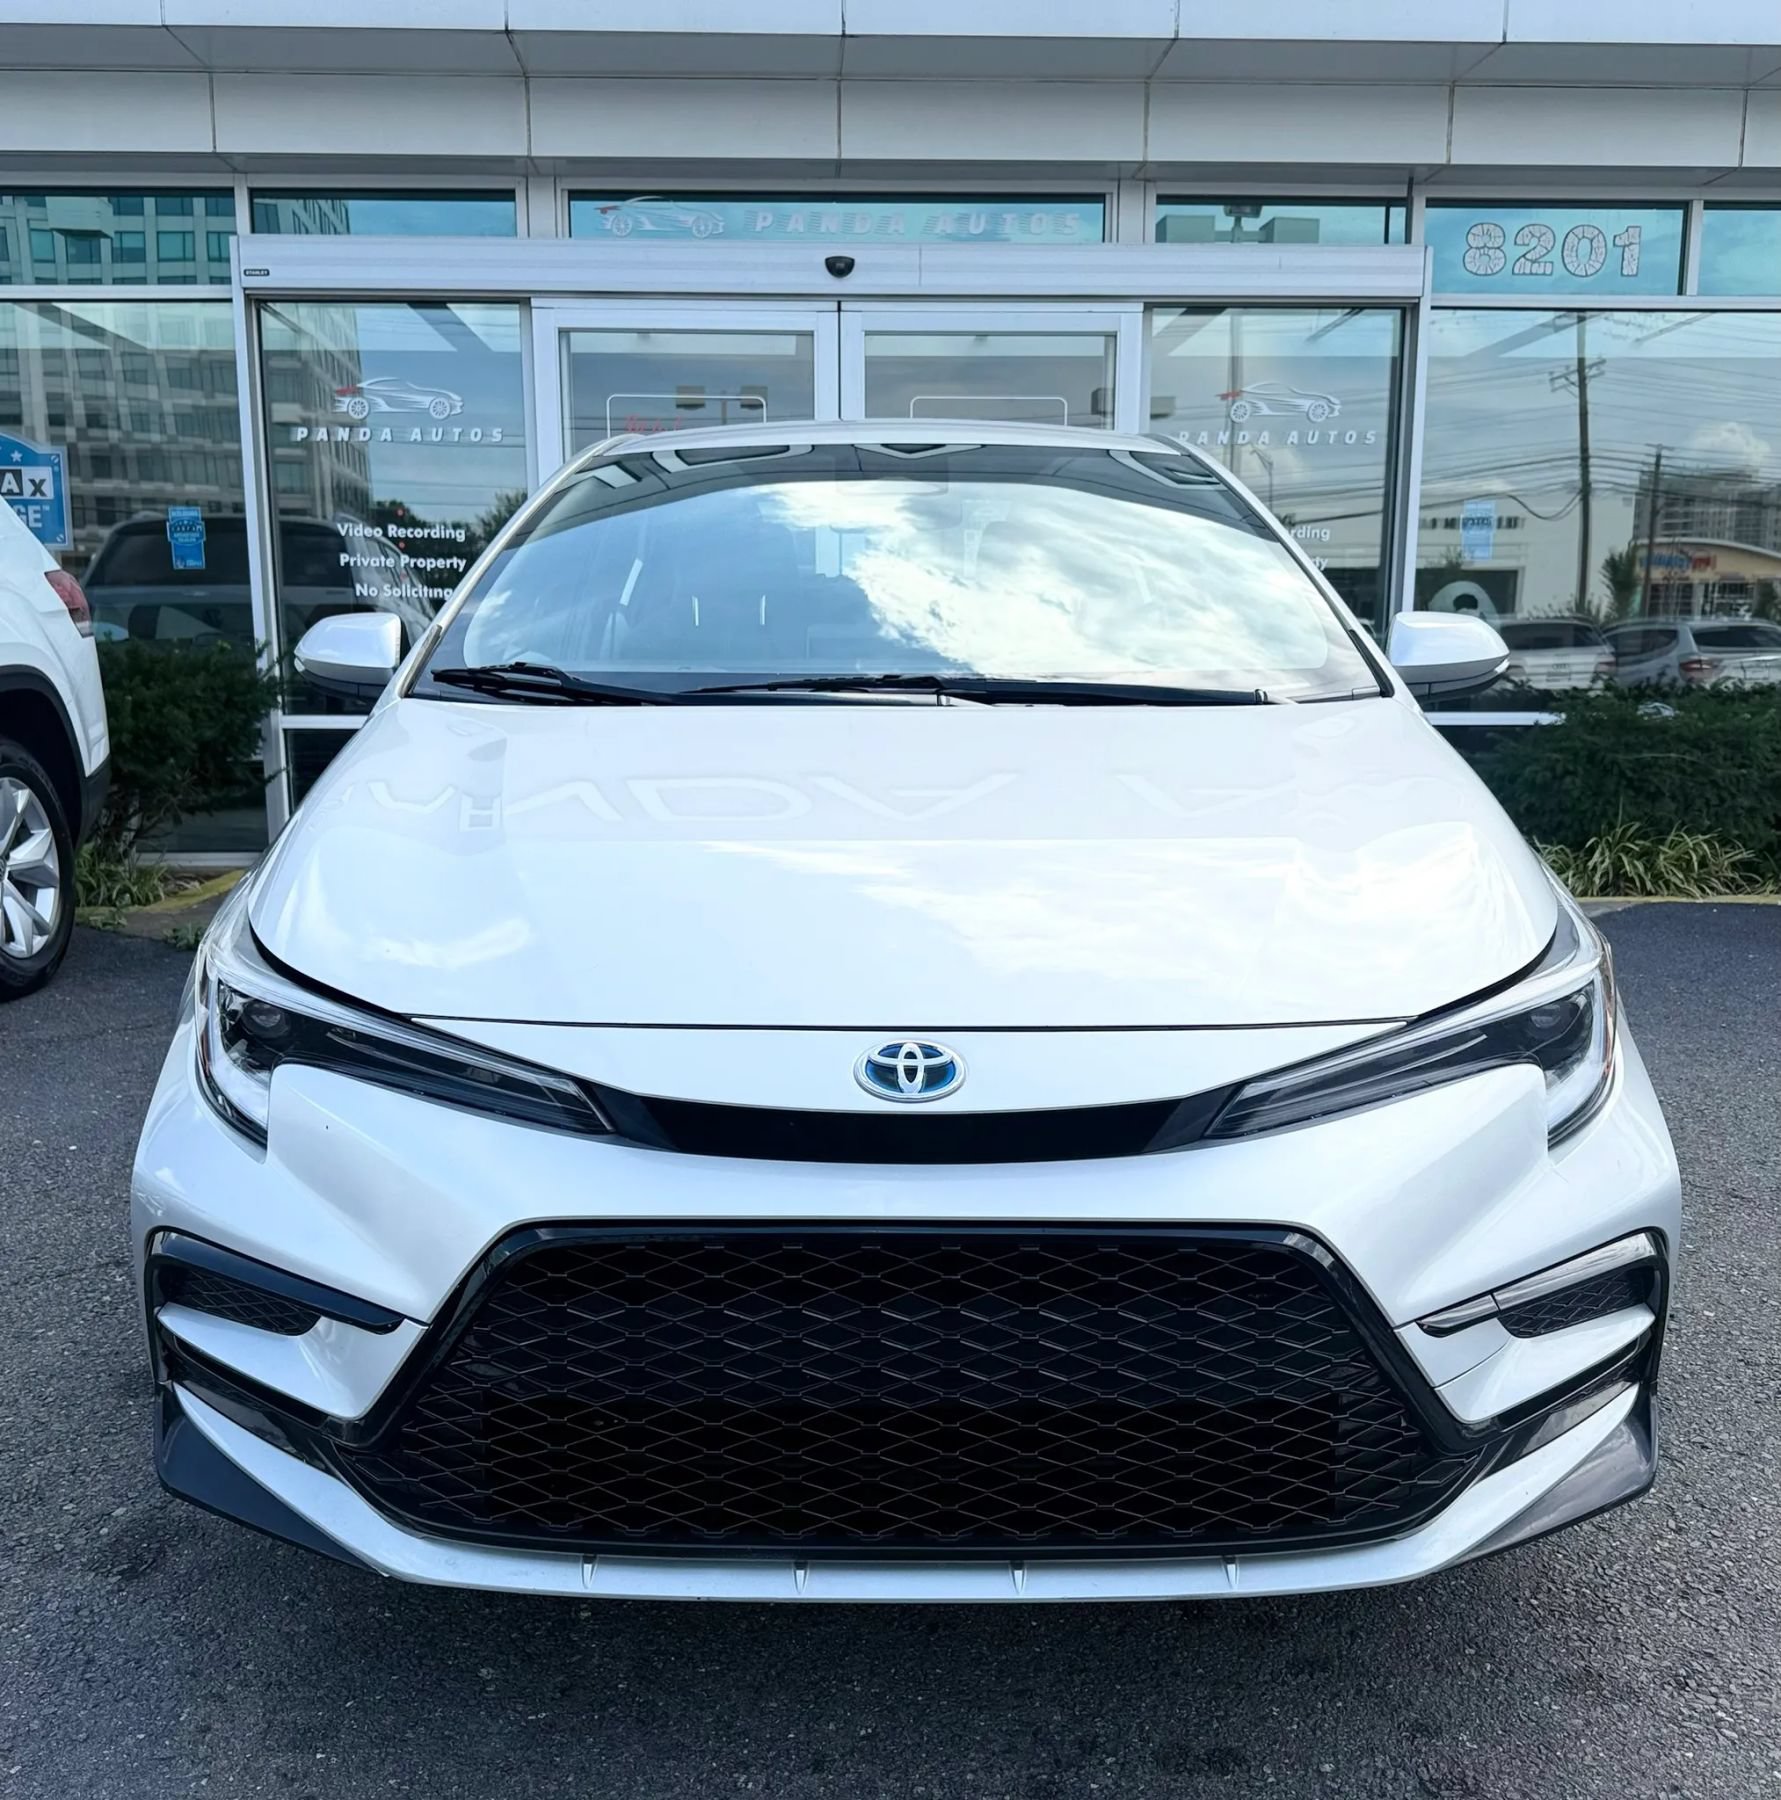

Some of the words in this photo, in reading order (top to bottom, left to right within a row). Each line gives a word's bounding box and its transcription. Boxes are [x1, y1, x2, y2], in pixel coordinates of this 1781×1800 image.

[753, 211, 905, 234] PANDA
[935, 212, 1081, 235] AUTOS
[1462, 222, 1642, 277] 8201
[295, 426, 393, 442] PANDA
[410, 427, 504, 442] AUTOS
[1178, 430, 1270, 445] PANDA
[1287, 430, 1378, 445] AUTOS
[336, 523, 383, 537] Video
[387, 523, 466, 543] Recording
[339, 553, 395, 567] Private
[400, 554, 467, 573] Property
[355, 583, 380, 597] No
